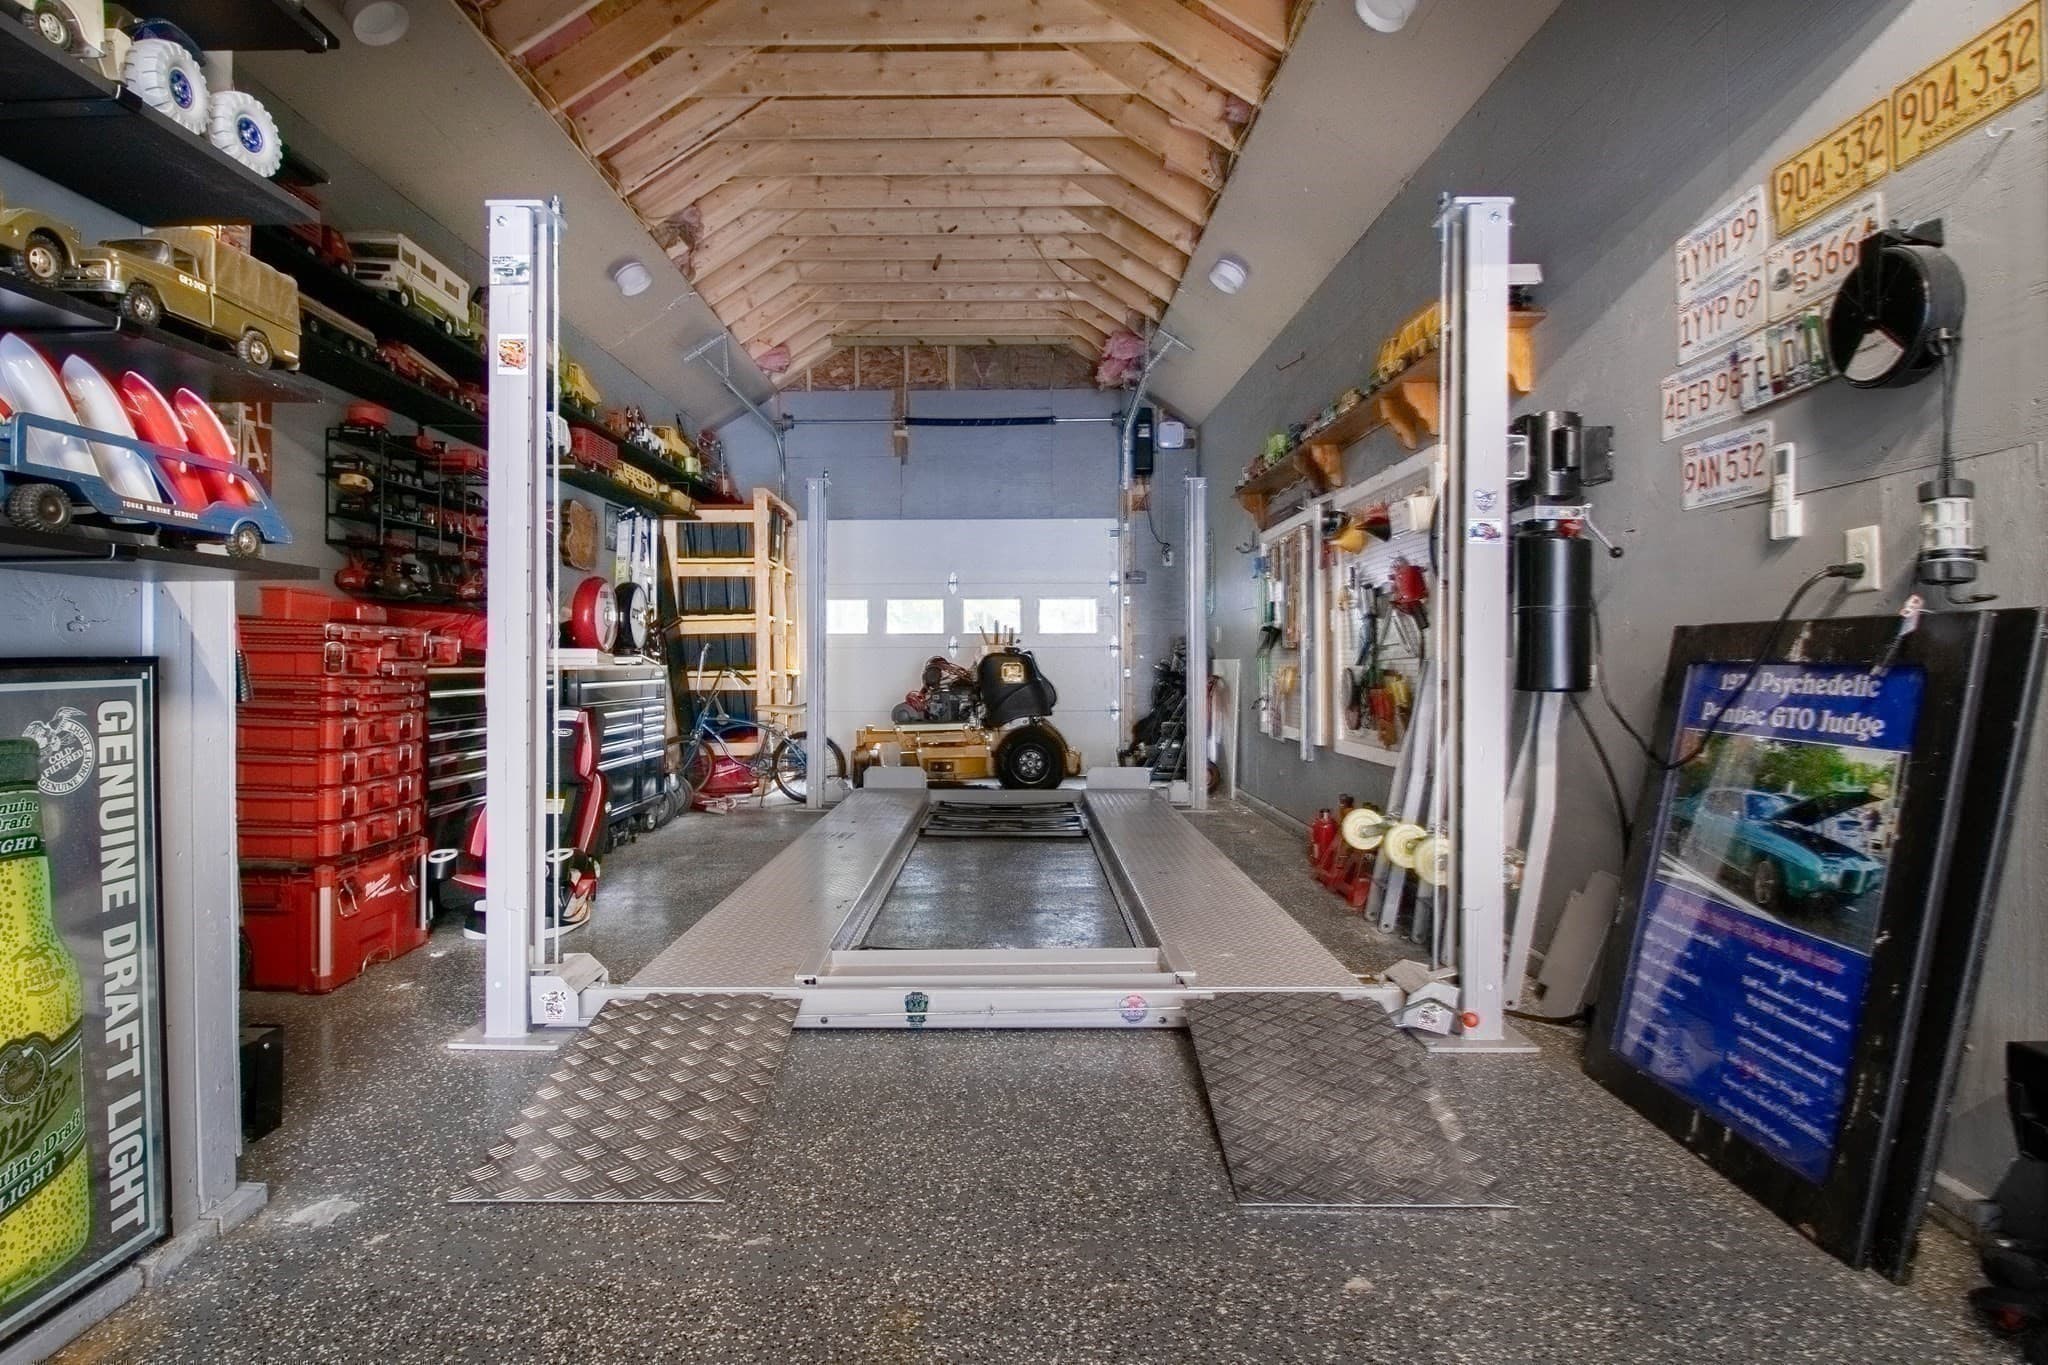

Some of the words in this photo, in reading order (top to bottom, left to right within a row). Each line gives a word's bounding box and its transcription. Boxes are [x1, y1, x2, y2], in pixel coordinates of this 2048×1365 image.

[1732, 208, 1759, 253] 99
[1735, 277, 1760, 319] 69
[1682, 455, 1721, 495] 9AN
[1726, 442, 1766, 483] 532
[146, 505, 171, 516] MARINE
[173, 509, 200, 521] SERVICE
[1757, 671, 1882, 701] Psychedelic
[1768, 705, 1817, 734] GTO
[1817, 709, 1887, 741] Judge
[43, 749, 84, 777] FILTERED
[0, 813, 32, 832] raft
[97, 700, 137, 913] GENUINE
[0, 836, 38, 853] GHT
[103, 920, 141, 1082] DRAFT
[43, 1107, 81, 1157] Draft
[107, 1090, 145, 1234] LIGHT
[0, 1157, 57, 1212] LIGHT
